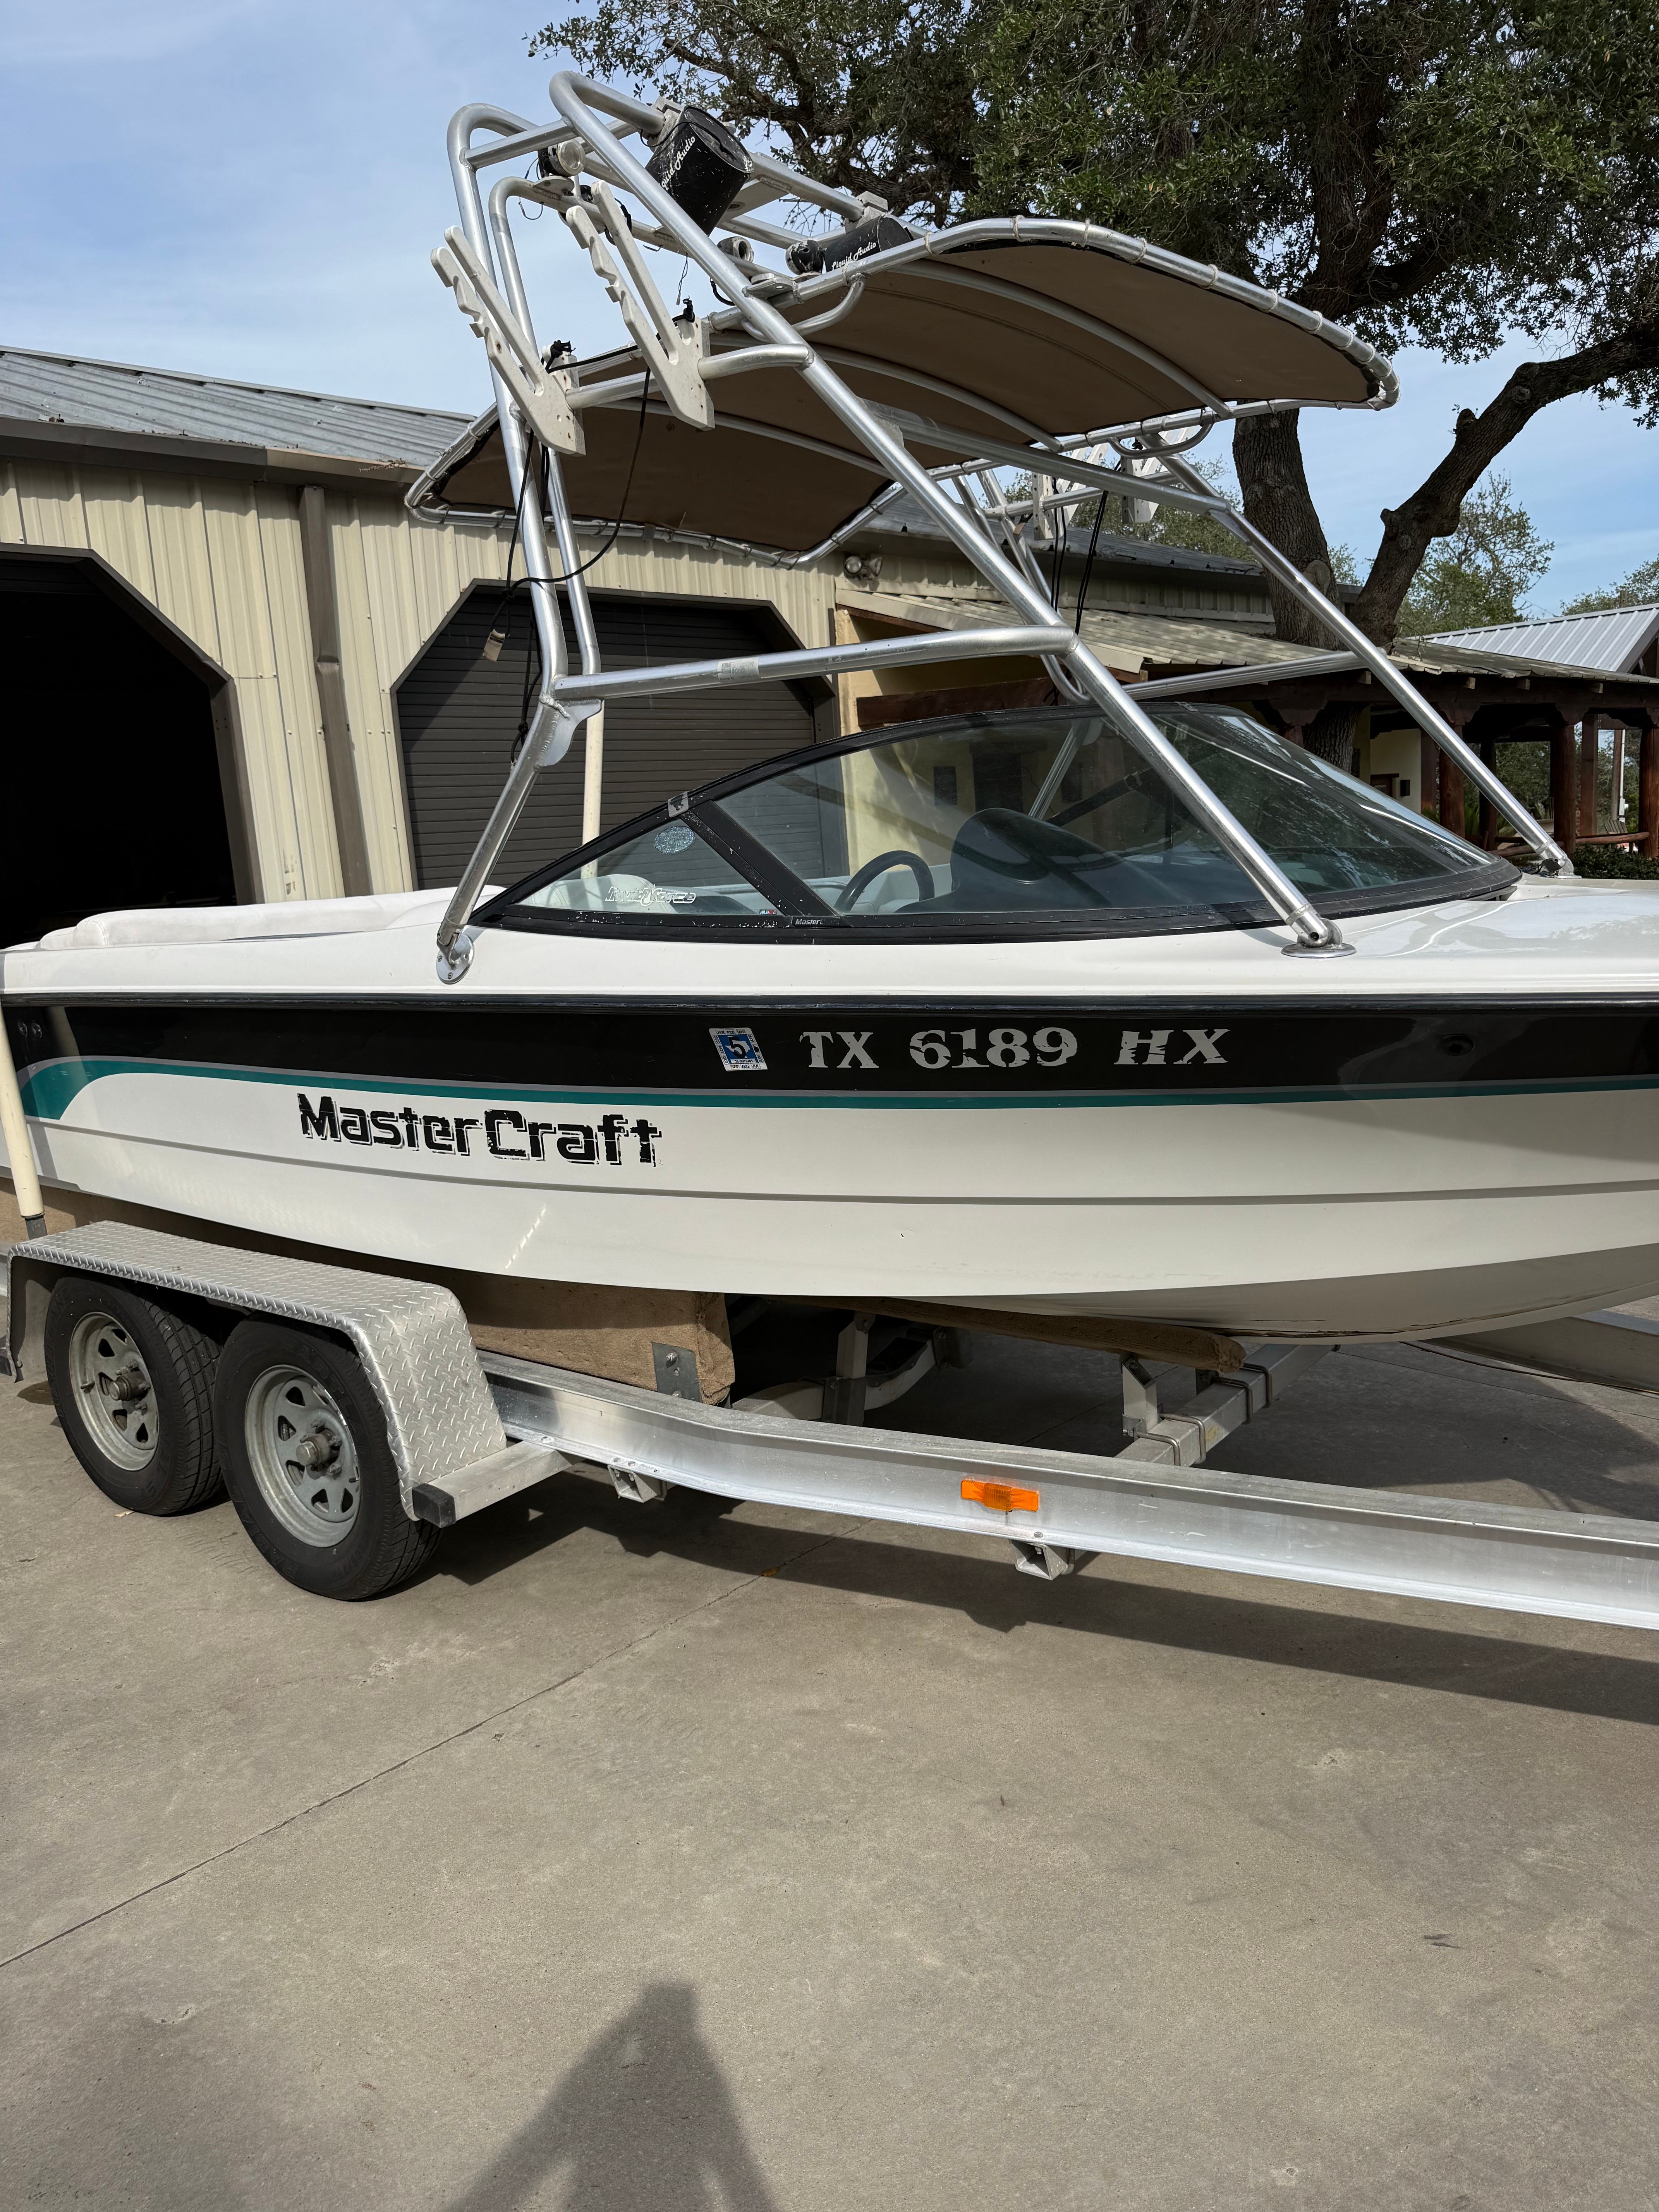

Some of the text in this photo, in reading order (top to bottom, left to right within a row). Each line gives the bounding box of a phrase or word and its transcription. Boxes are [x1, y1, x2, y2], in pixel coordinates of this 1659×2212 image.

[661, 136, 696, 191] quid Audio
[832, 242, 876, 270] Liquid Audio
[727, 1036, 747, 1058] 5
[800, 1027, 1231, 1069] TX 6189 HX
[297, 1093, 661, 1167] MasterCraft
